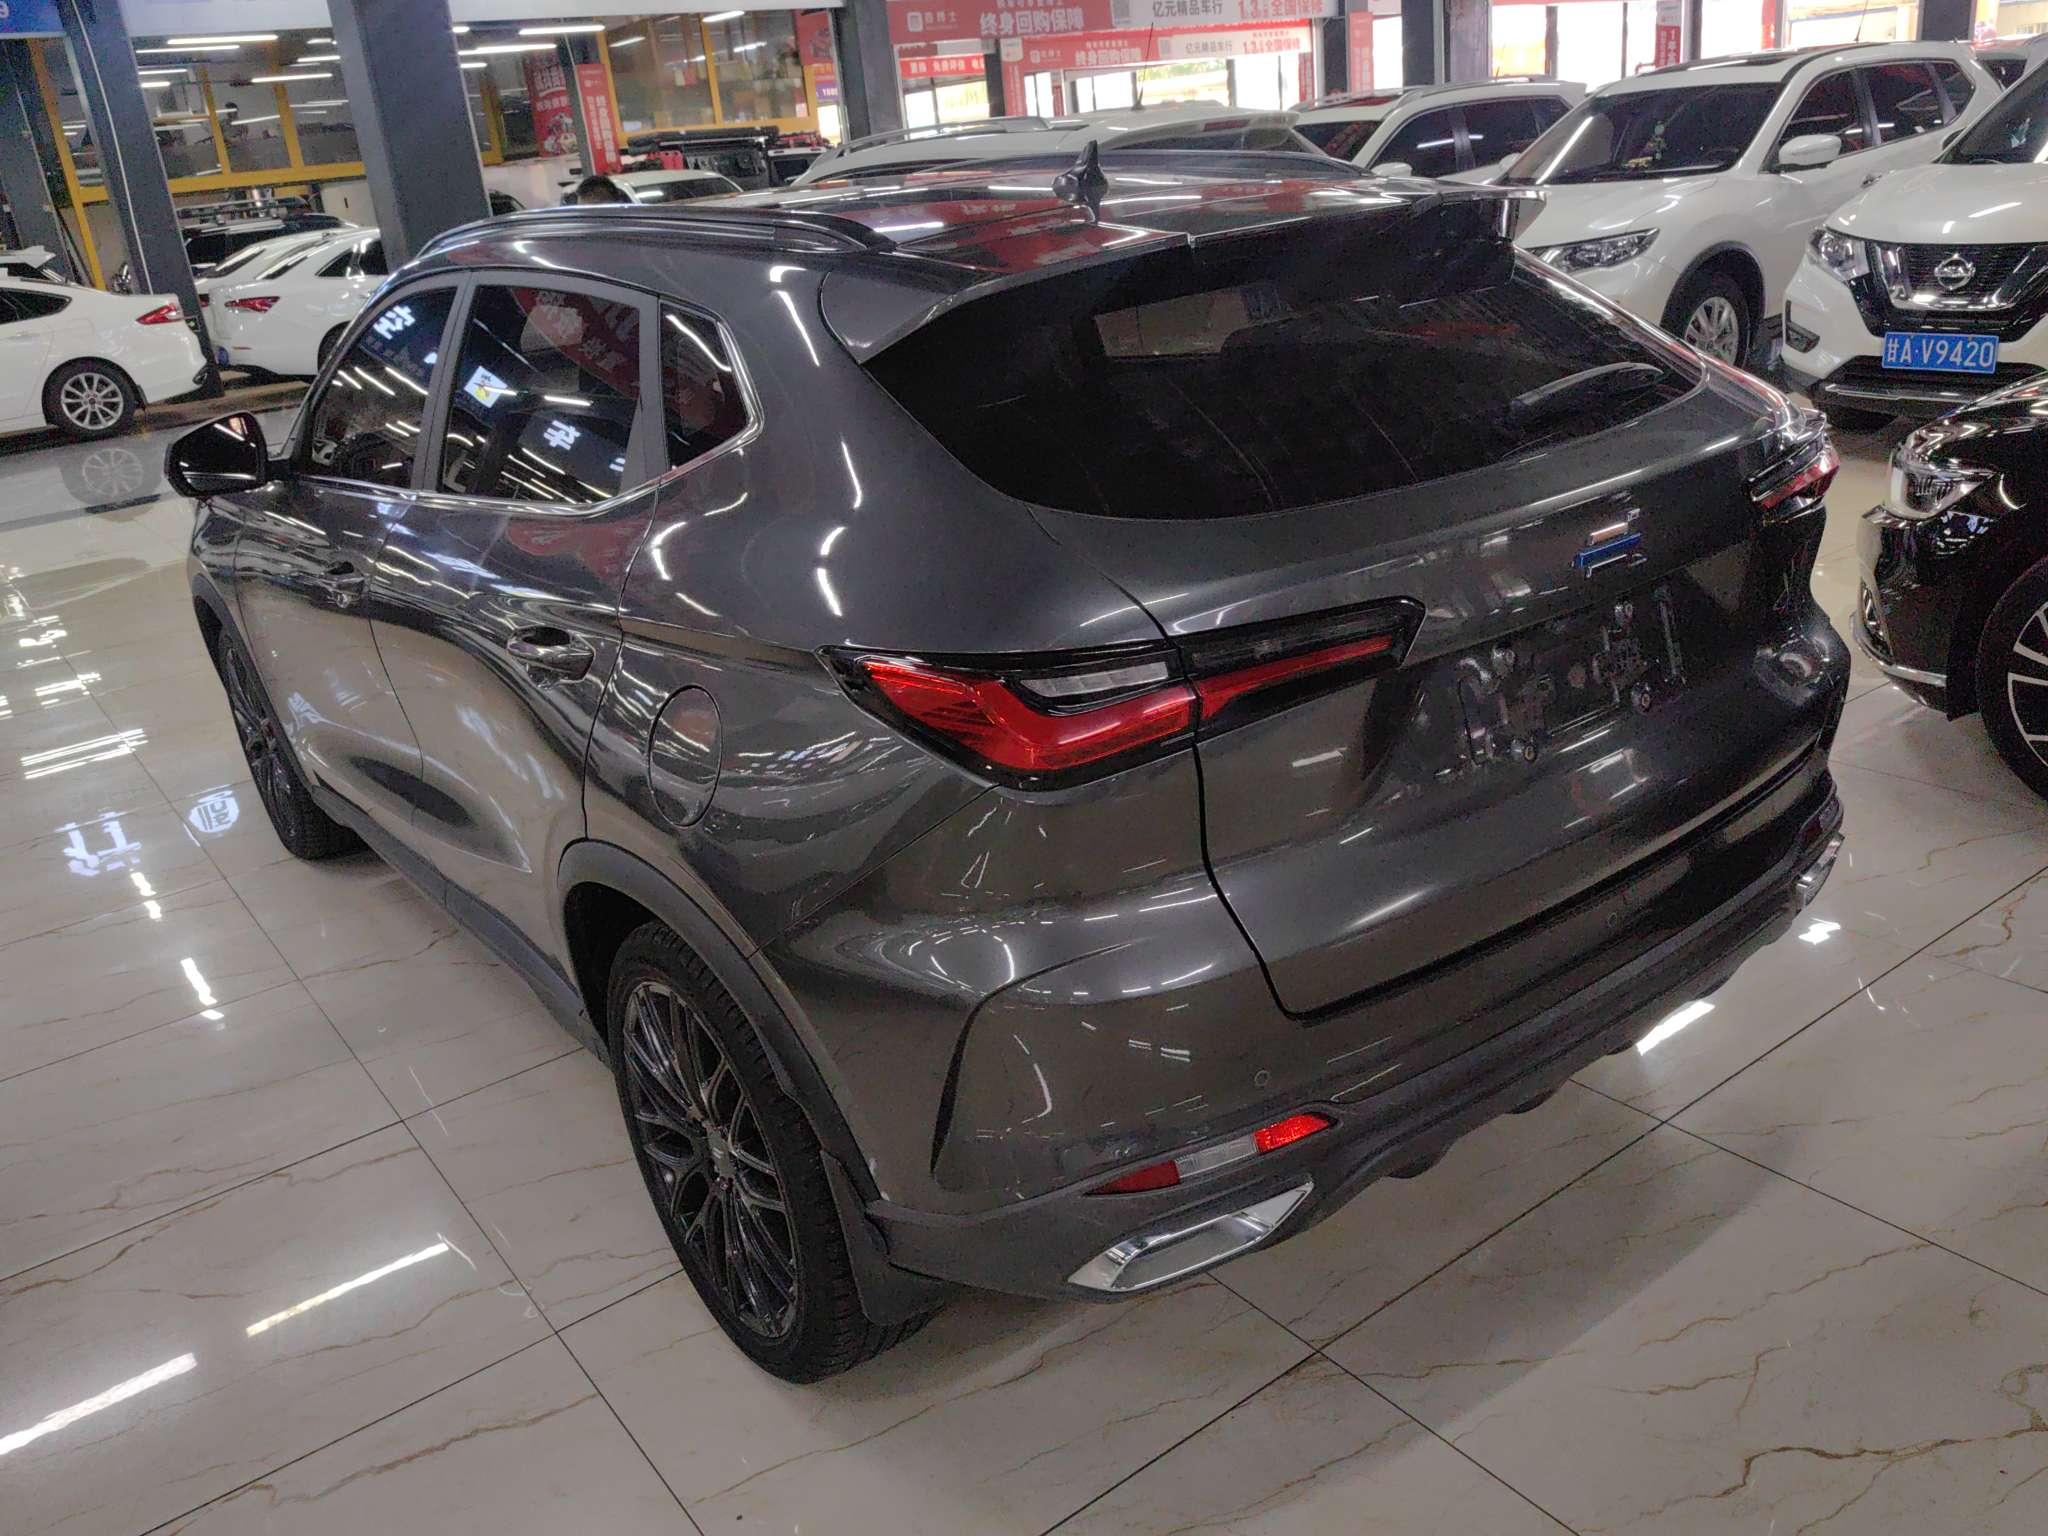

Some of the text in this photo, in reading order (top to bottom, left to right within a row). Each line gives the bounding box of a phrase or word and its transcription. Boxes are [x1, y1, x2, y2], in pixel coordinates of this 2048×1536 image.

[979, 7, 1085, 36] 终身回购保障
